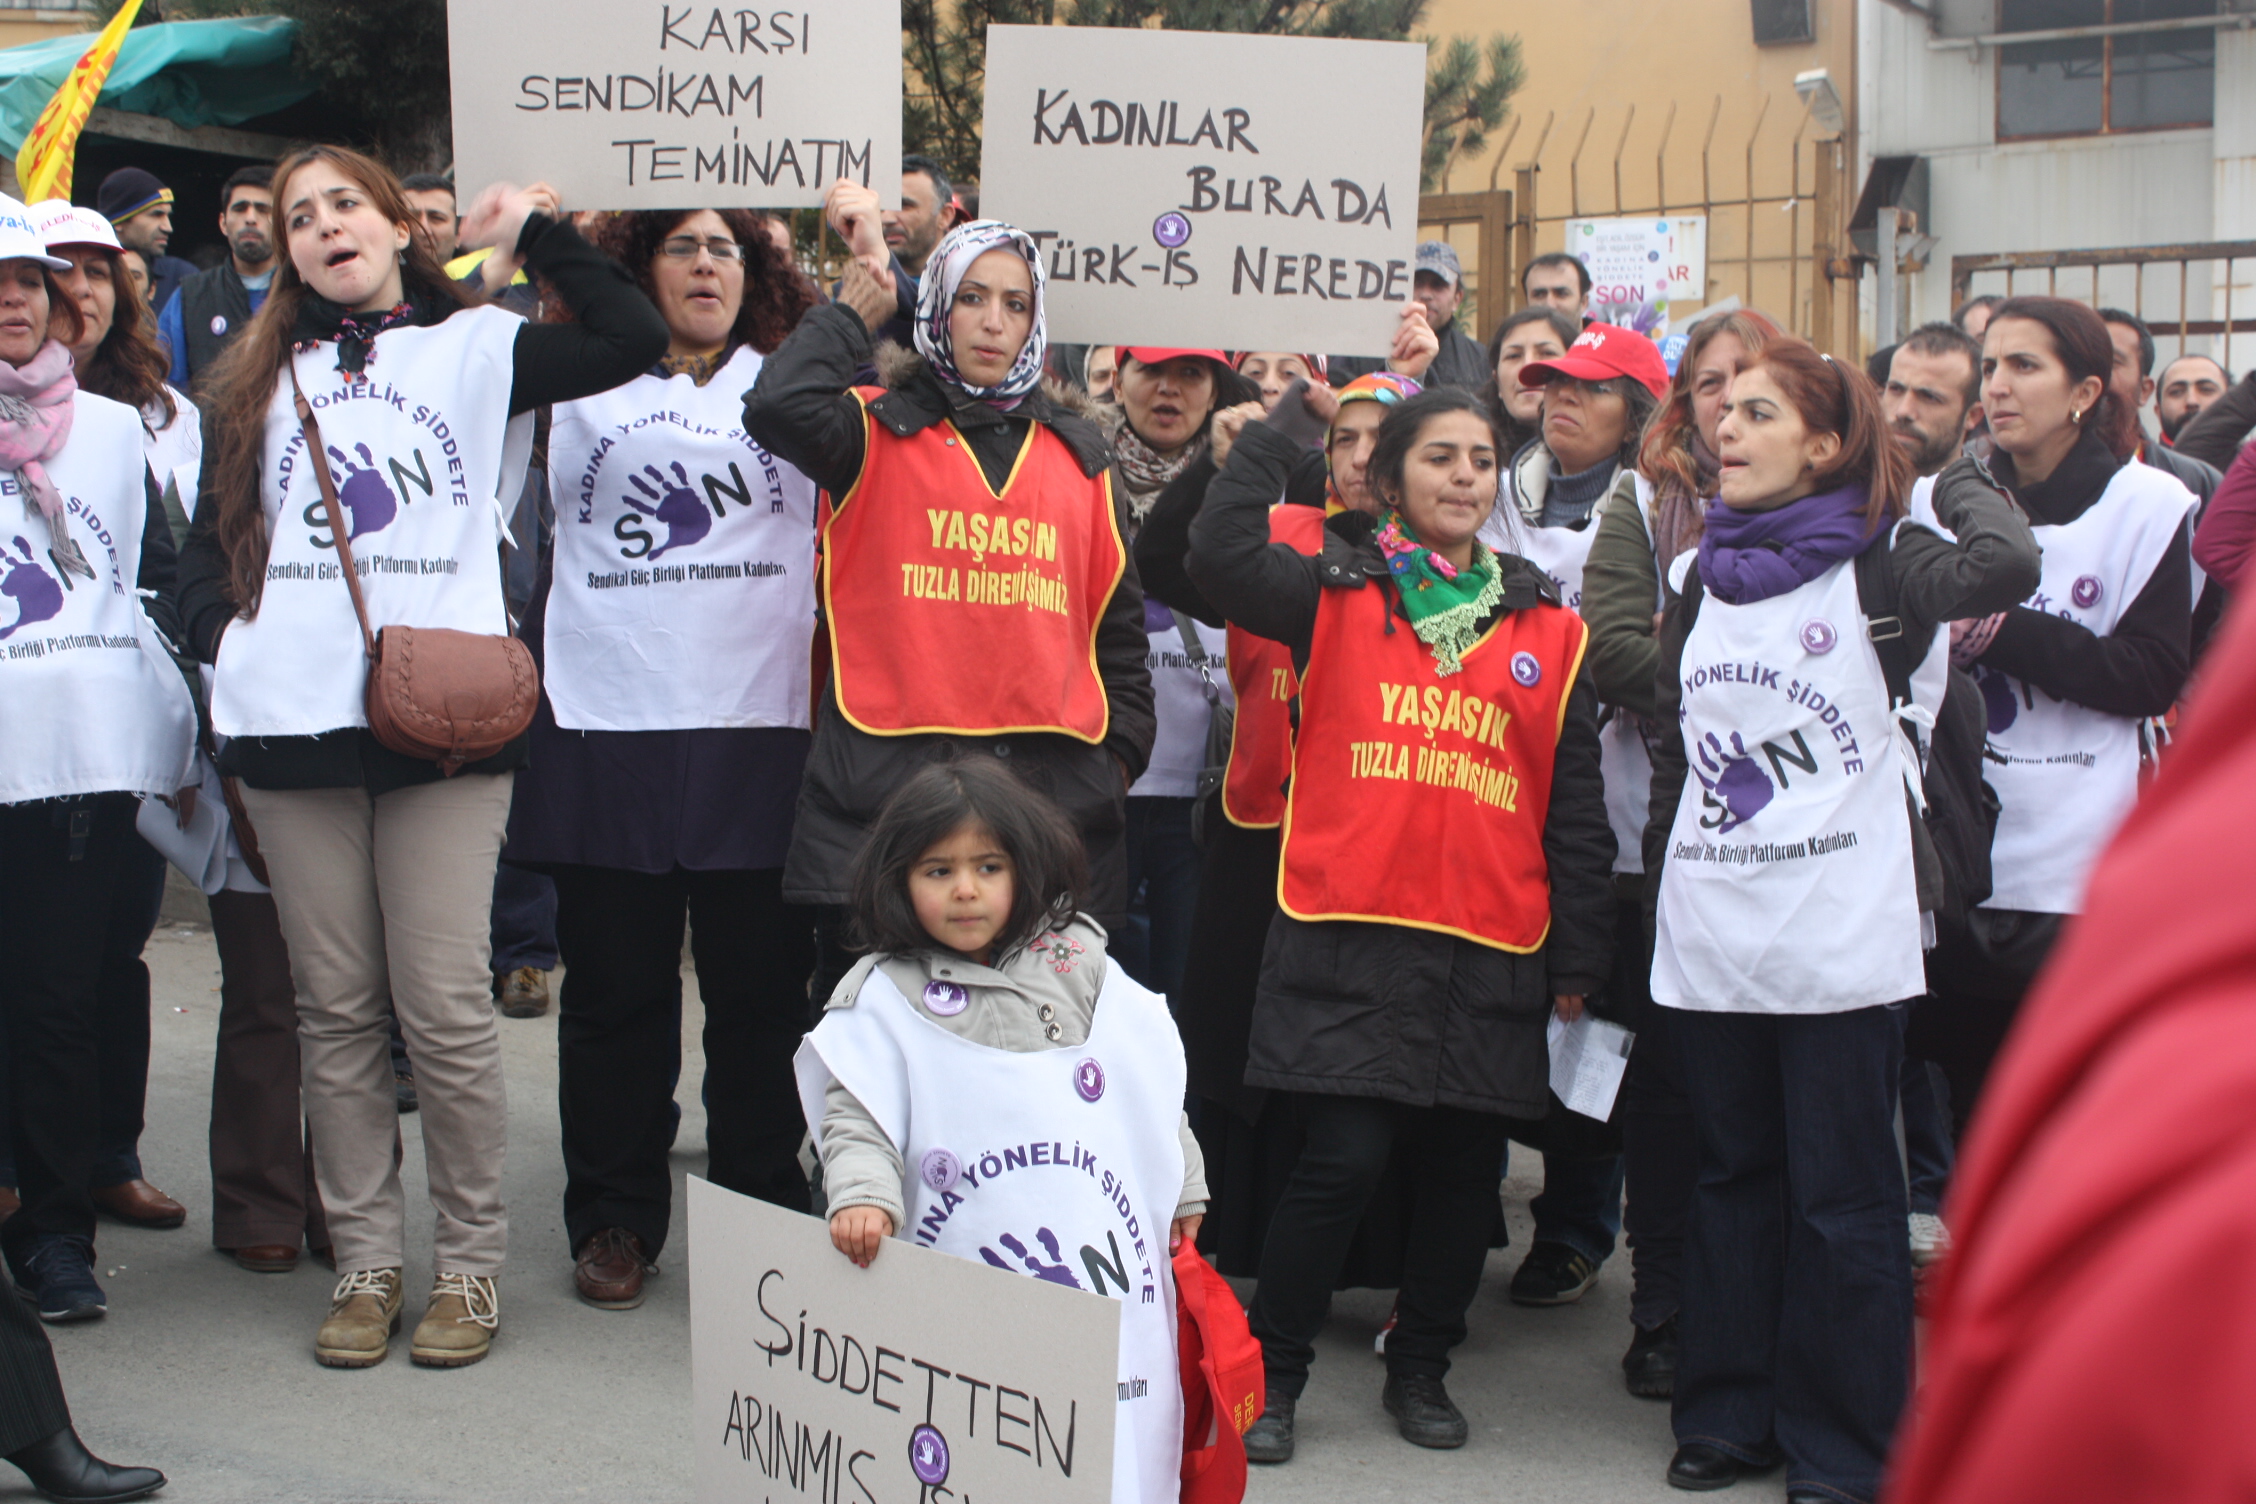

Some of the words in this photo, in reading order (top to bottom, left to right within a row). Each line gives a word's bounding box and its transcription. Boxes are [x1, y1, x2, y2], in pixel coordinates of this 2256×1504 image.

[659, 3, 809, 54] KARŞI
[515, 65, 764, 118] SENDİKAM
[1033, 88, 1260, 154] KADINLAR
[612, 125, 872, 190] TEMİNATIM
[1179, 165, 1392, 230] BURADA
[1232, 245, 1409, 301] NEREDE
[1595, 285, 1645, 304] SON
[311, 382, 407, 413] ÖNELİK
[412, 405, 470, 507] ŞİDDETE
[578, 436, 616, 525] KADINA
[66, 496, 126, 597] ŞİDDETE
[926, 508, 1057, 563] YAŞASIN
[266, 562, 315, 582] Sendikal
[318, 560, 339, 582] Güç
[587, 570, 629, 590] Sendikal
[630, 568, 650, 587] Güç
[653, 565, 685, 584] Birliği
[689, 562, 741, 582] Platformu
[743, 560, 787, 578] Kadınları
[901, 563, 960, 602] TUZLA
[966, 562, 1069, 617] DİRENİŞİMİZ
[8, 638, 46, 659] Birliği
[46, 633, 102, 654] Platformu
[1379, 682, 1512, 752] YAŞASIN
[1685, 660, 1782, 694] YÖNELİK
[1786, 679, 1864, 776] ŞİDDETE
[1350, 741, 1409, 781] TUZLA
[1750, 843, 1805, 864] Platformu
[1807, 830, 1858, 857] Kadınları
[961, 1139, 1098, 1190] YÖNELİK
[1101, 1169, 1155, 1304] ŞİDDETE
[753, 1268, 1077, 1478] ŞİDDETTEN
